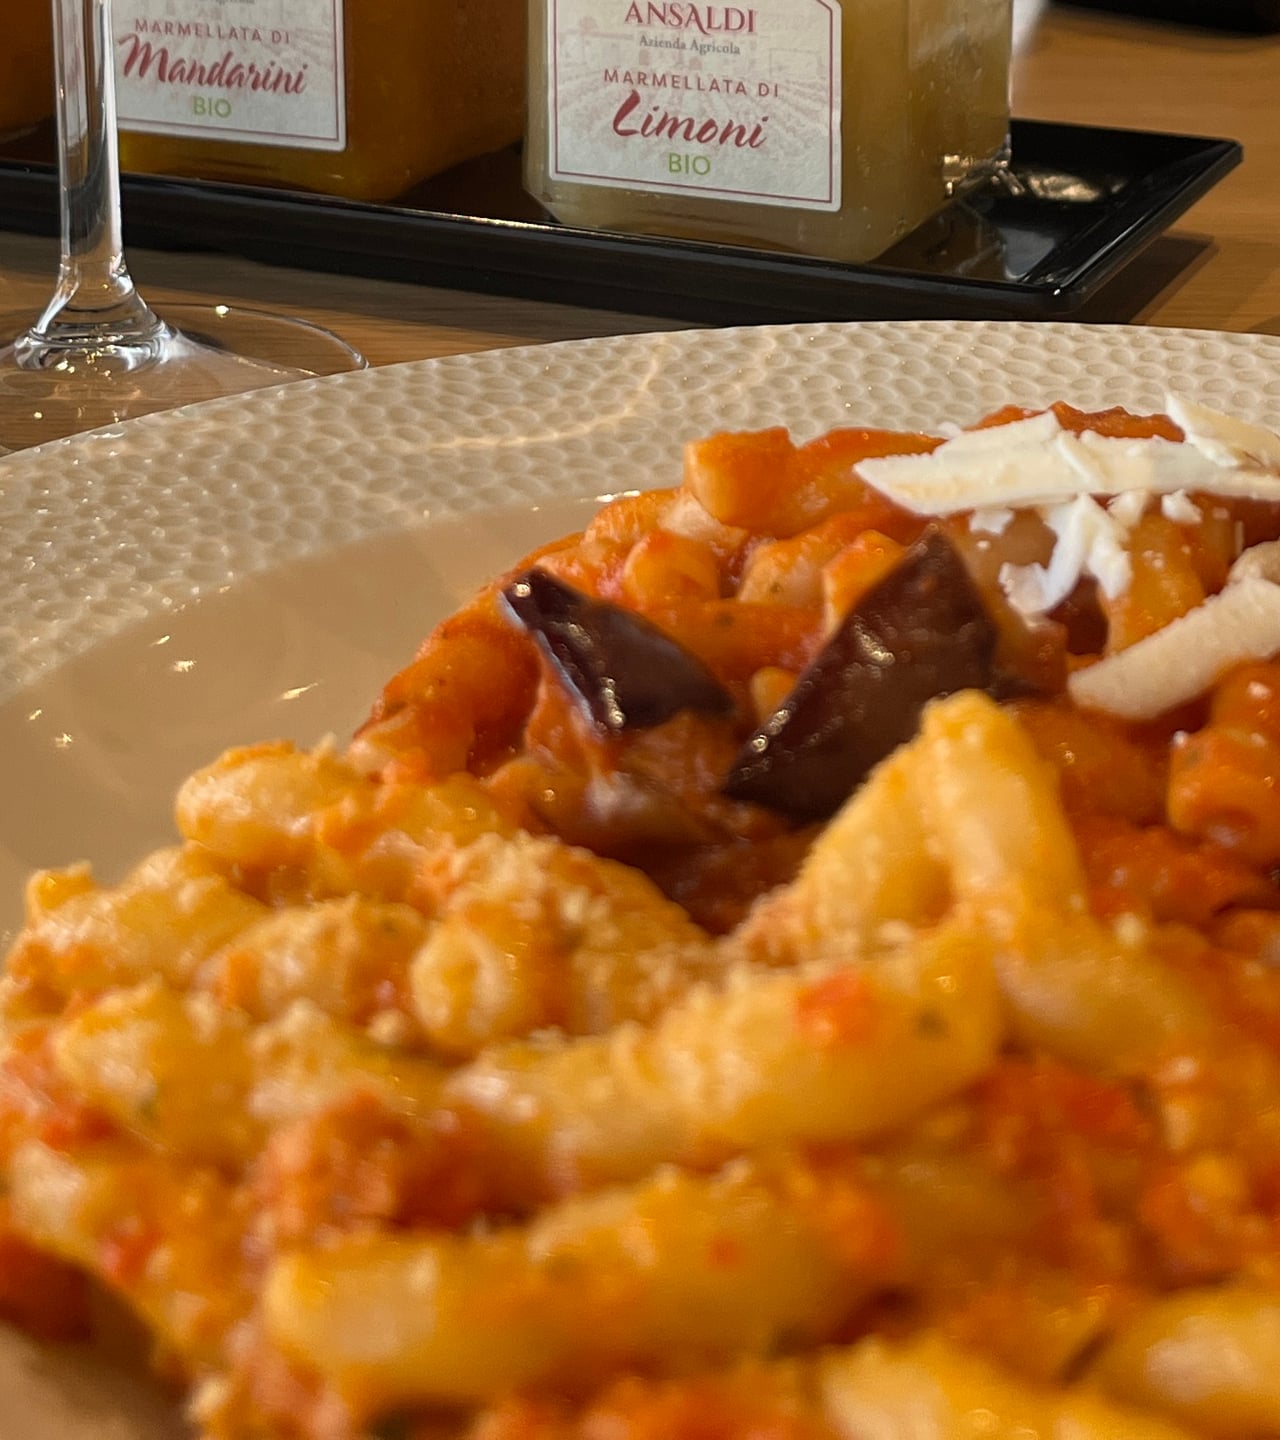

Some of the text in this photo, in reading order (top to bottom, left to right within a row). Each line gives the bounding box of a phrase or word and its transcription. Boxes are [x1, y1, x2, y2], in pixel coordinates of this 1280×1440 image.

[135, 18, 290, 44] MARMELLATA DI
[624, 0, 756, 35] ANSALDI
[639, 35, 740, 55] Azienda Agricola
[117, 33, 308, 94] Mandarini
[604, 68, 779, 97] MARMELLATA DI
[192, 96, 232, 119] BIO
[612, 89, 769, 148] Limoni
[669, 152, 711, 176] BIO
